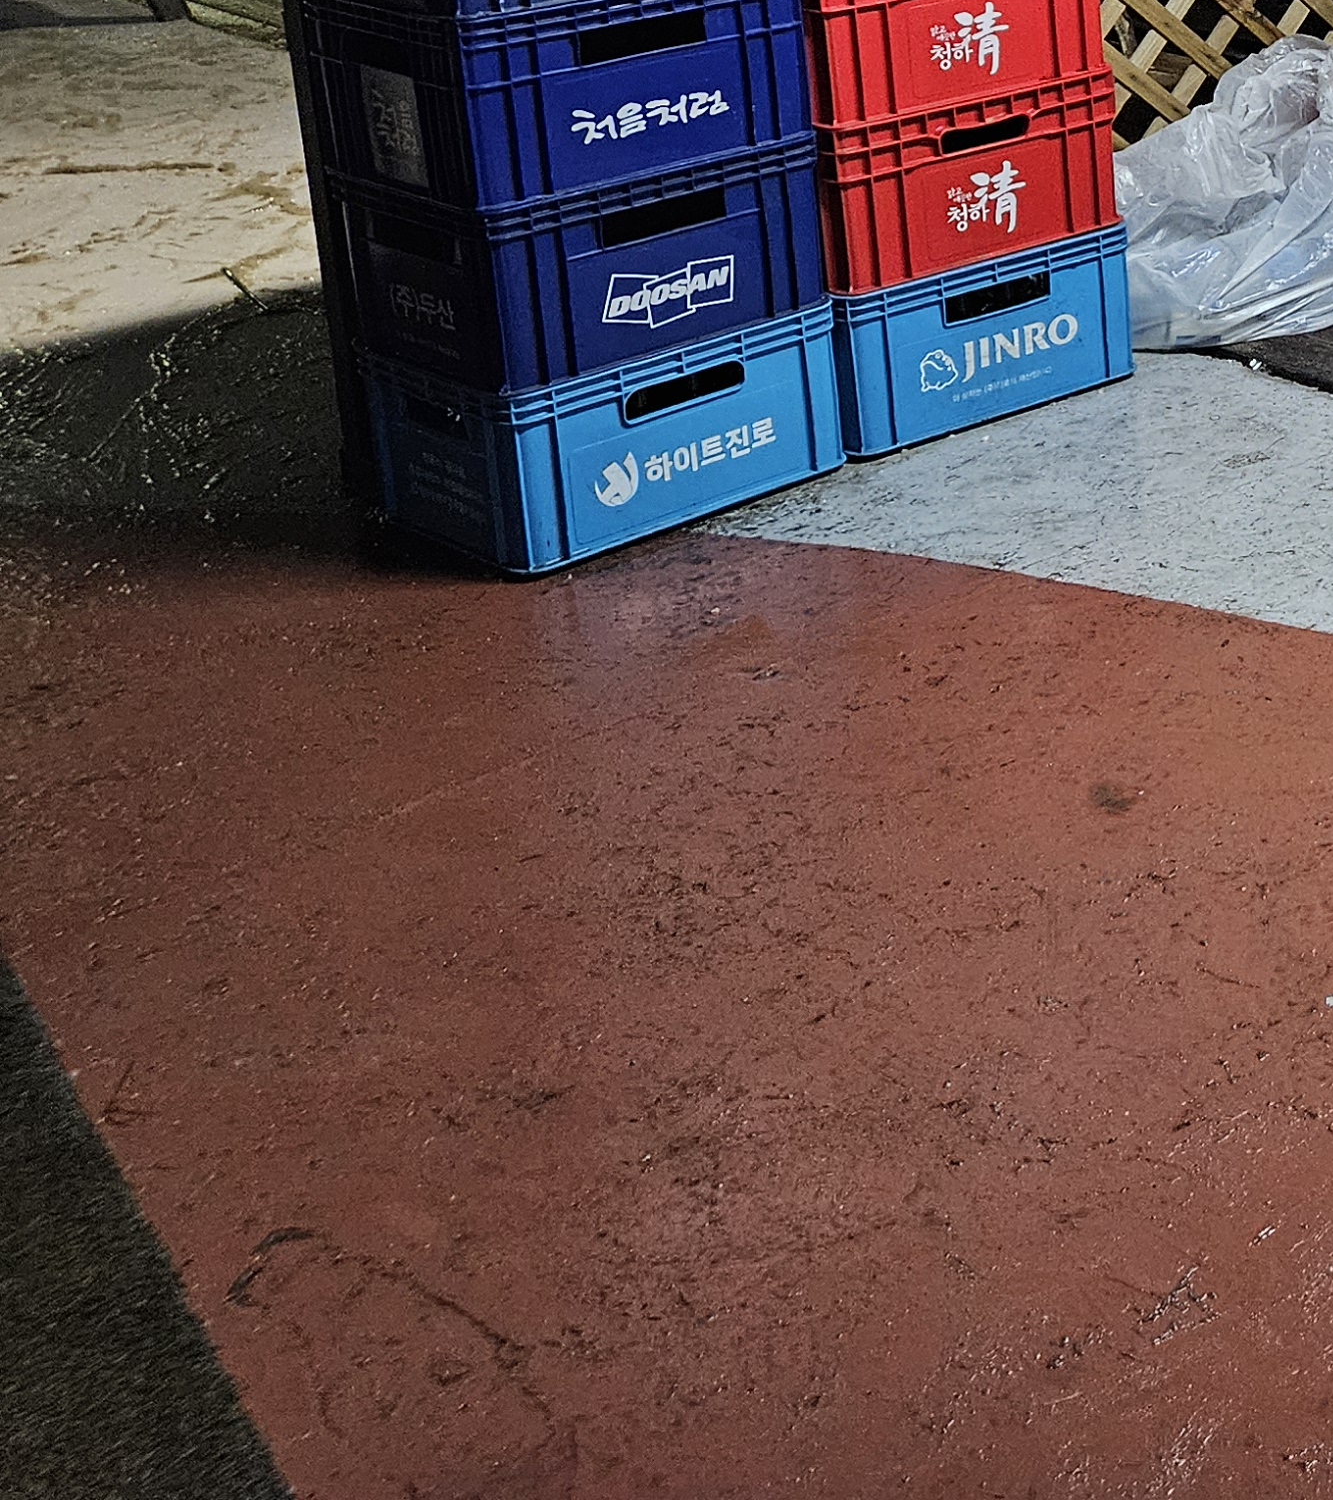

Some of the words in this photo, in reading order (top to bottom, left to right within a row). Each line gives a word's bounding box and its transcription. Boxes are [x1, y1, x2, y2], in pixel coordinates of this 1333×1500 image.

[930, 41, 974, 71] 청하
[571, 89, 730, 145] 처음처럼
[947, 202, 990, 232] 청하
[608, 265, 729, 318] DOOSAN
[962, 313, 1079, 383] JINRO
[644, 417, 777, 482] 하이트진로
